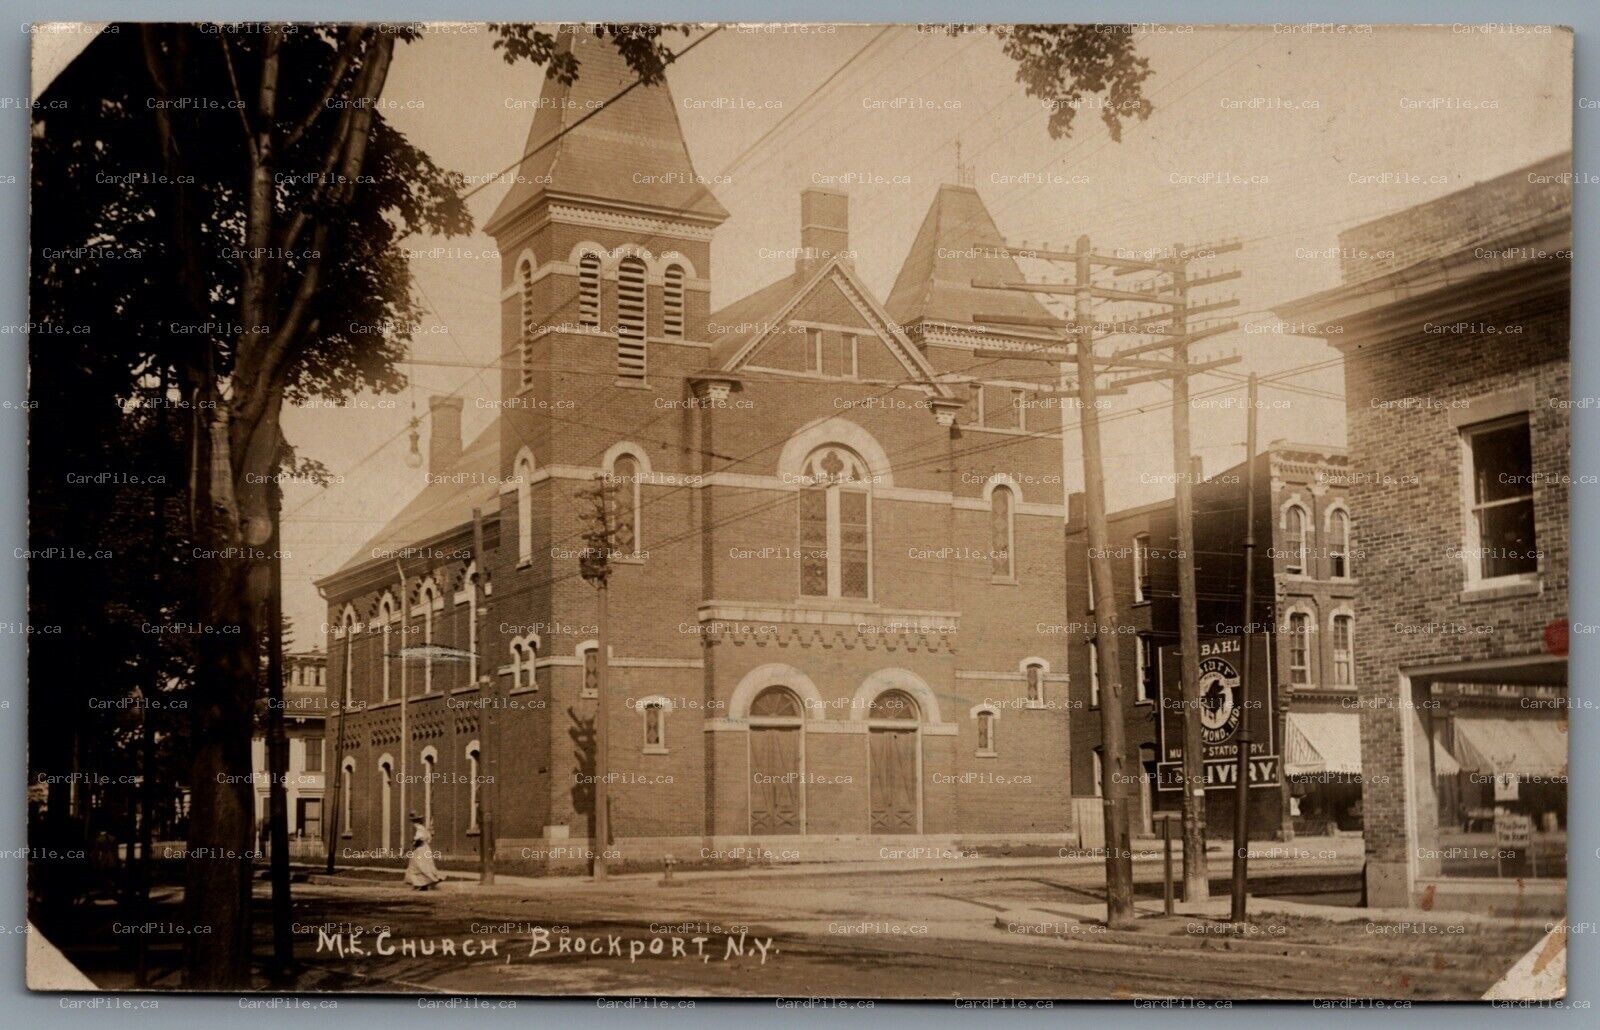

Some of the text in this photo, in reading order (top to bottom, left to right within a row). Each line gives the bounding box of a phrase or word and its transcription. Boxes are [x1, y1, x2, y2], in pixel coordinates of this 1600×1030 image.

[1201, 640, 1240, 656] BAHL
[1209, 743, 1265, 757] STATIORY.
[1207, 762, 1276, 783] IVERY.
